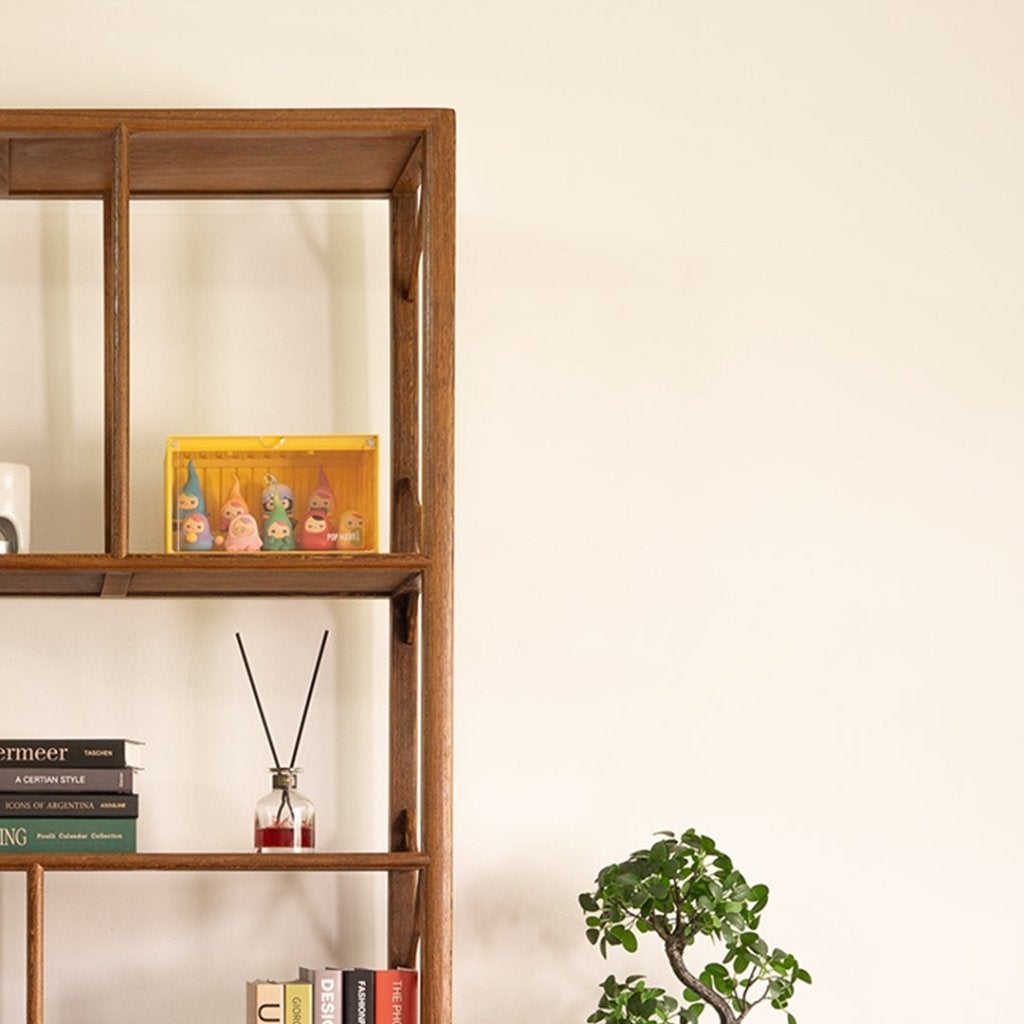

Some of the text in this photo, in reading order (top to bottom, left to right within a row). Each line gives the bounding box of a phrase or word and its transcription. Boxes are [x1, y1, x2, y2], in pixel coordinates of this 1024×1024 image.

[15, 776, 22, 784] A
[60, 776, 86, 784] STYLE
[5, 802, 95, 810] ICONS OF ARGENTINA
[90, 832, 123, 840] Collection
[392, 980, 402, 1003] THE
